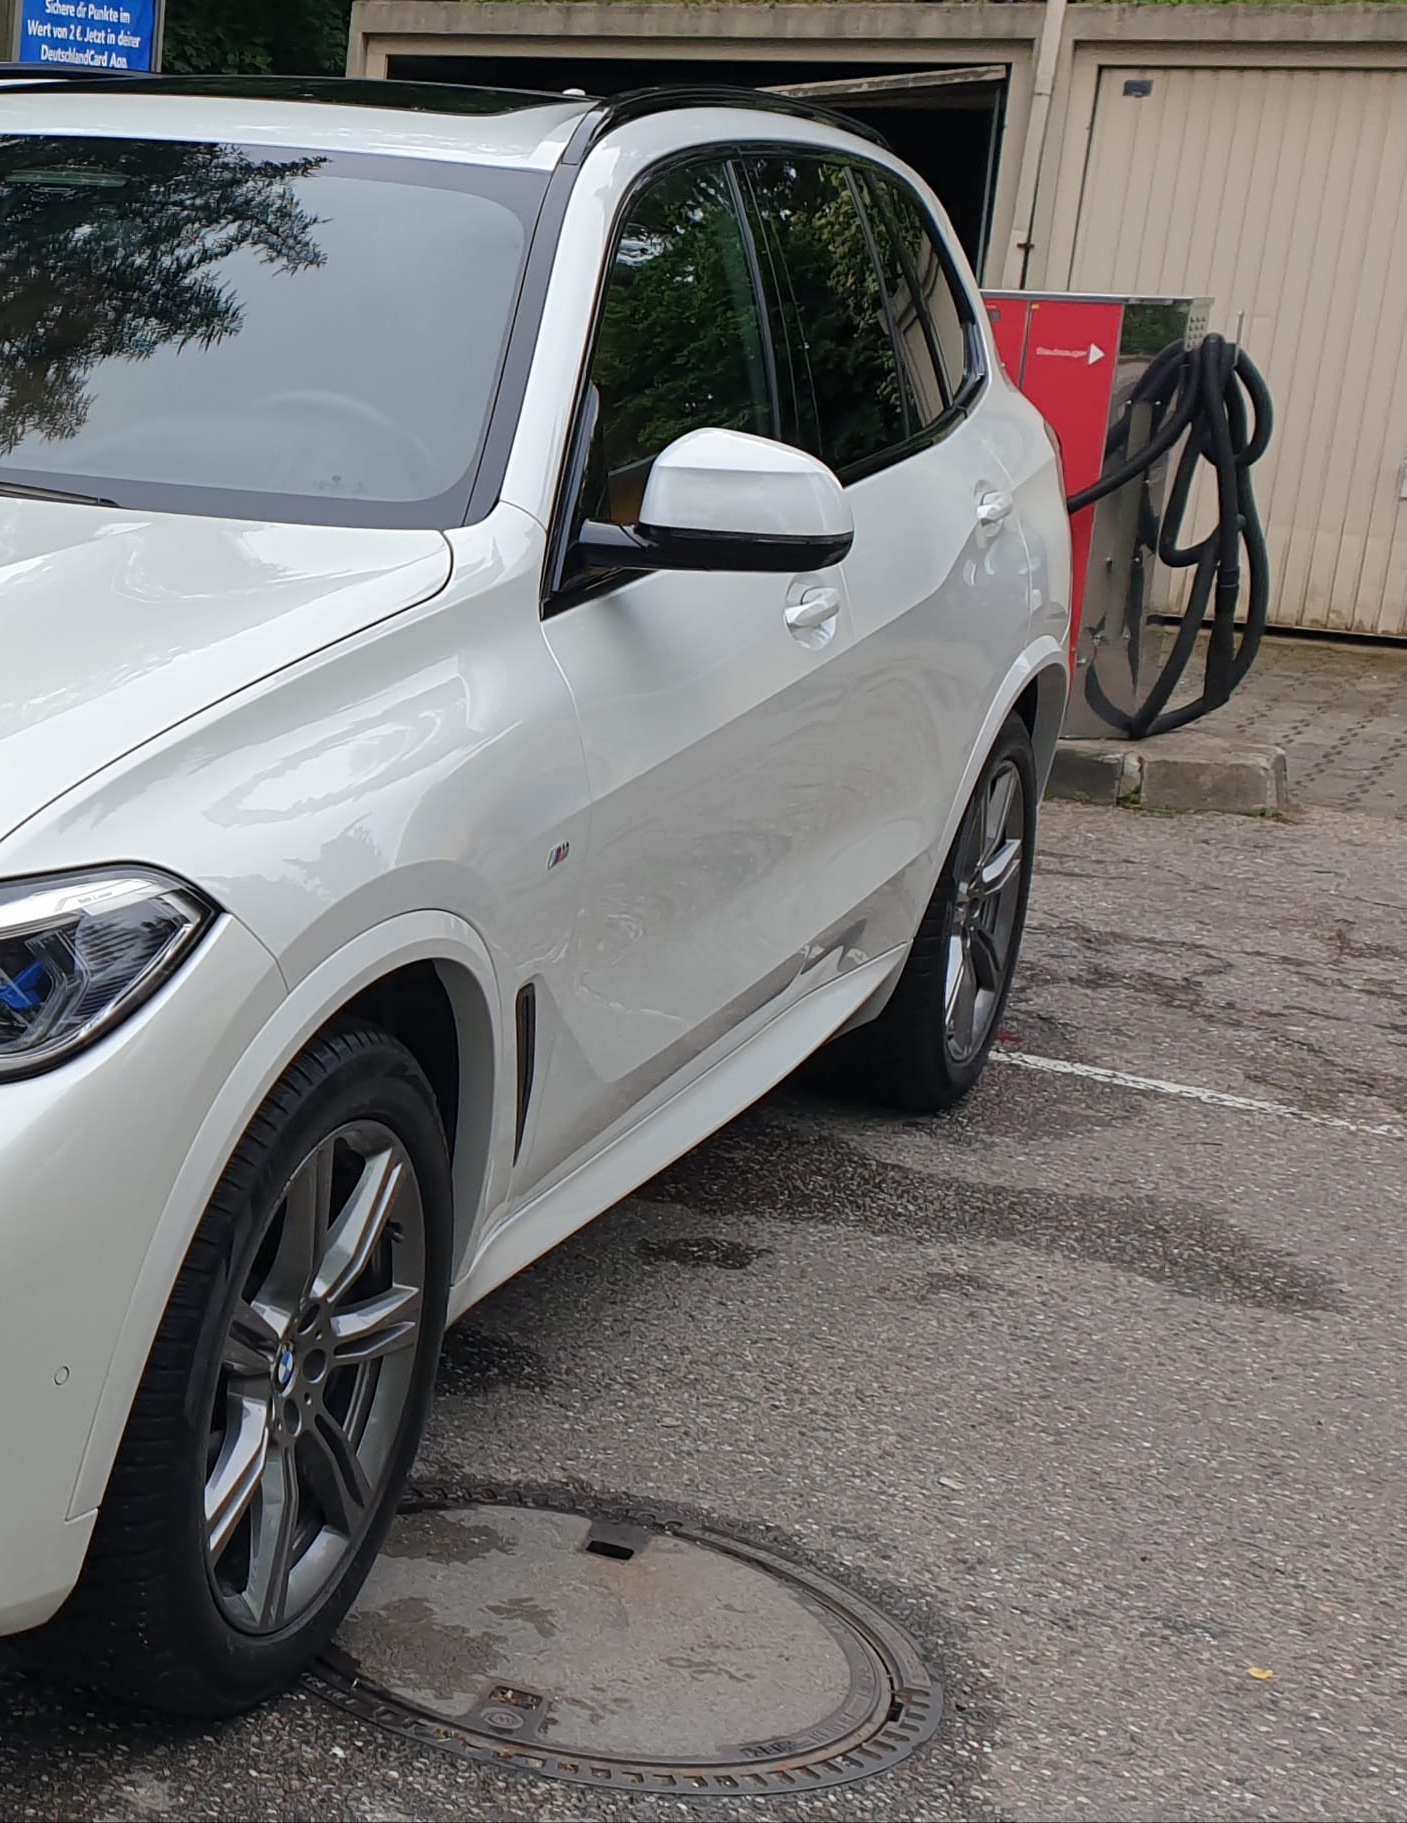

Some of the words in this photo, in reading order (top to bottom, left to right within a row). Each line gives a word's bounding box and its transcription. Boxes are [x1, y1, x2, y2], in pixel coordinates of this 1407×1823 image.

[44, 0, 75, 16] Sichere
[88, 4, 119, 22] Punkte
[120, 7, 131, 24] im
[27, 20, 52, 37] Wert
[53, 26, 67, 39] von
[69, 25, 74, 40] 2
[84, 26, 106, 45] Jetzt
[107, 28, 116, 45] in
[117, 30, 142, 48] deiner
[40, 44, 109, 67] DeutschlandCard
